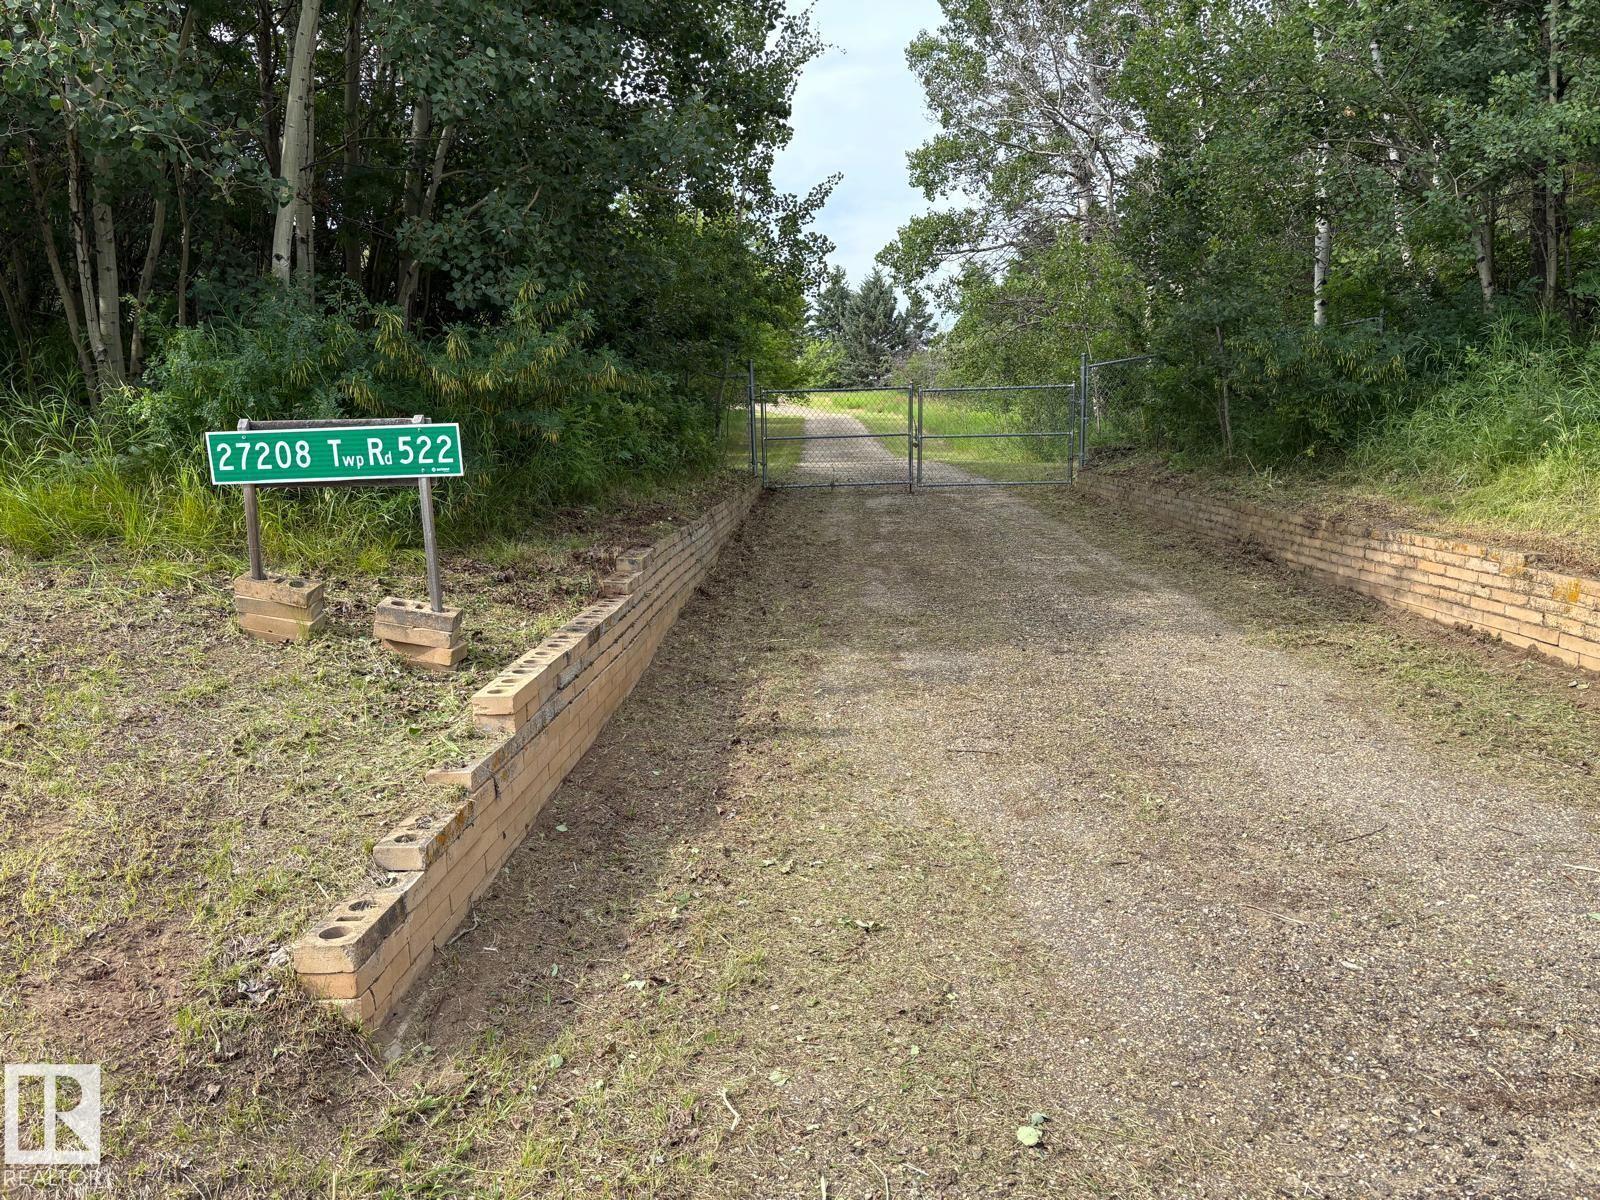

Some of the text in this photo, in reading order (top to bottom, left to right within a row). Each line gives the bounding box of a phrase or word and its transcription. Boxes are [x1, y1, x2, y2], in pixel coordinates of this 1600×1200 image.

[216, 435, 454, 470] 27208 Twp Rd 522
